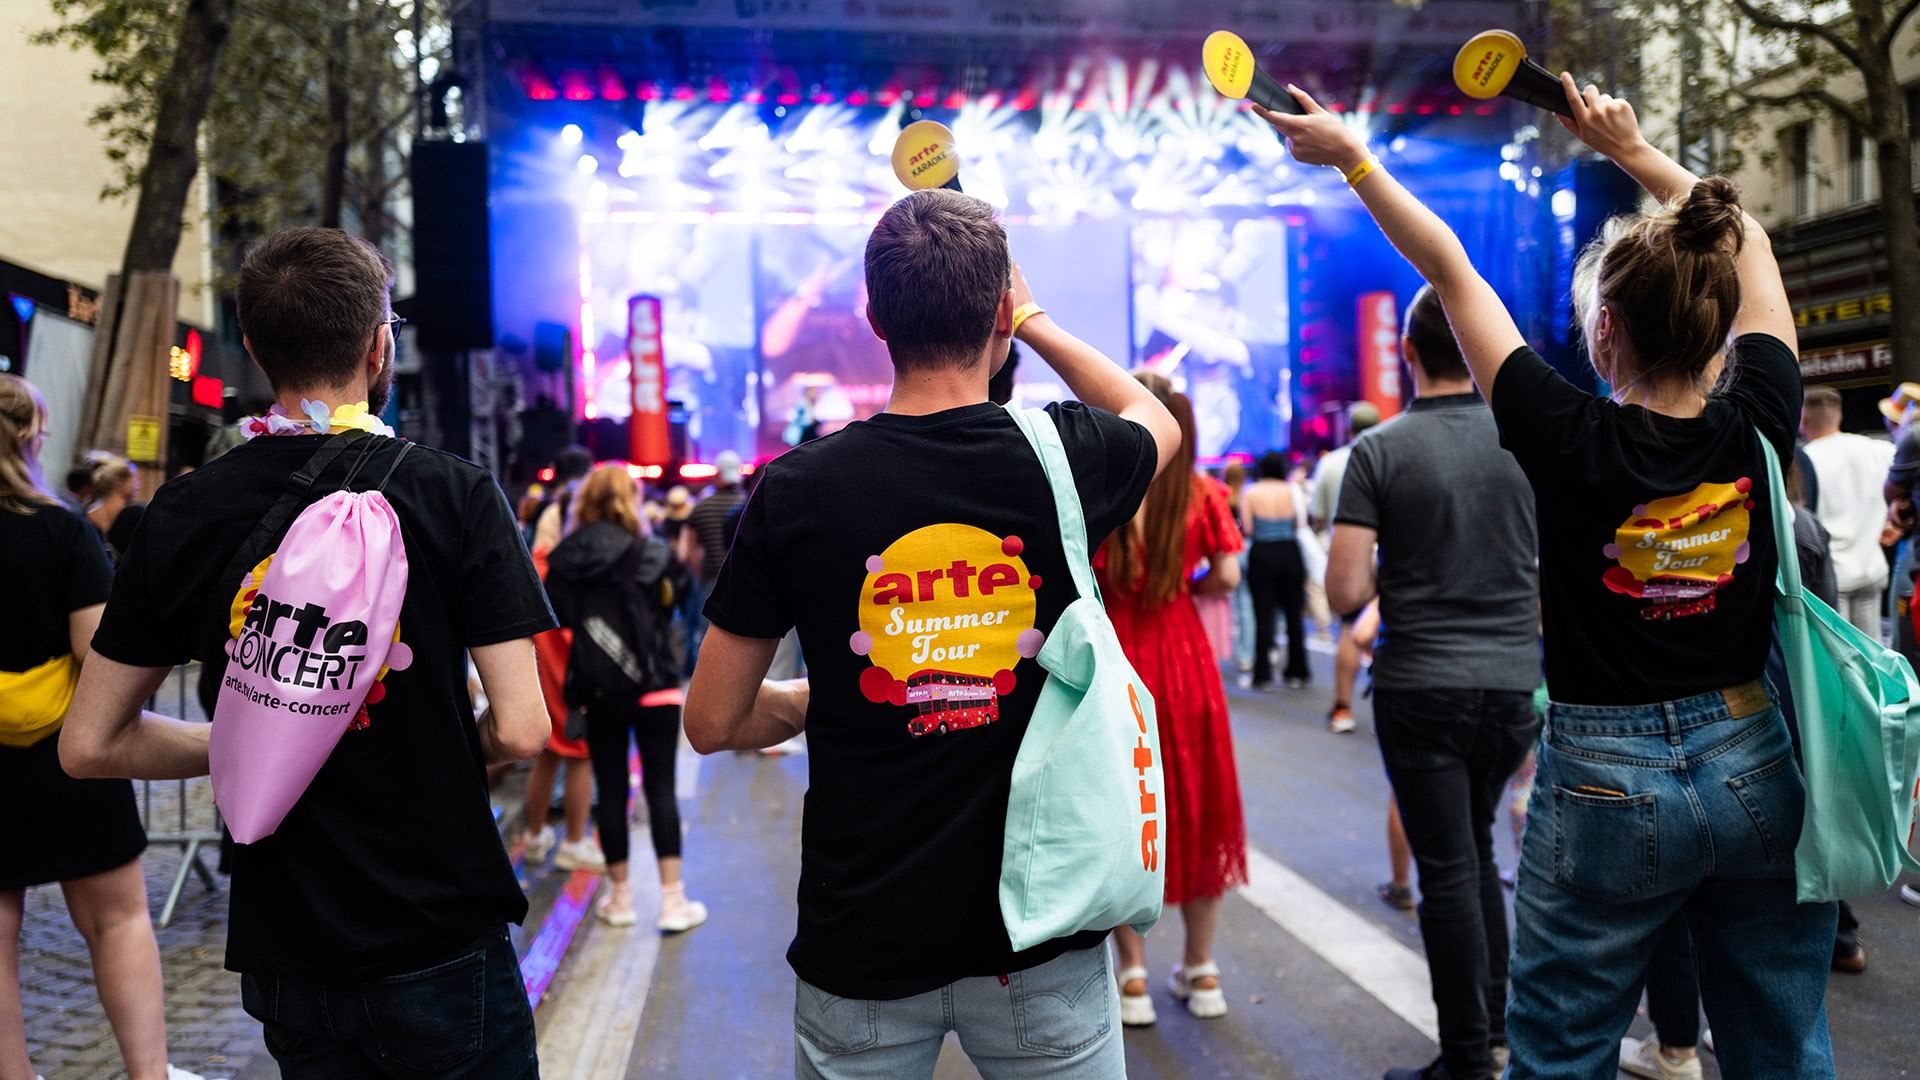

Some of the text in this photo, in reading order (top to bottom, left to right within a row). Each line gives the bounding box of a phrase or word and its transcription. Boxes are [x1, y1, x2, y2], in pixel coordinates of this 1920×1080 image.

[1472, 50, 1493, 81] arte
[909, 143, 939, 165] arte
[1635, 528, 1732, 551] Summer
[1653, 551, 1710, 571] Tour
[873, 559, 1020, 606] arte
[244, 593, 368, 655] arte
[885, 606, 1010, 636] Summer
[232, 627, 365, 691] CONCERT
[911, 633, 981, 664] Tour
[225, 675, 351, 716] arte.tv/arte-concert
[1127, 682, 1158, 873] arte
